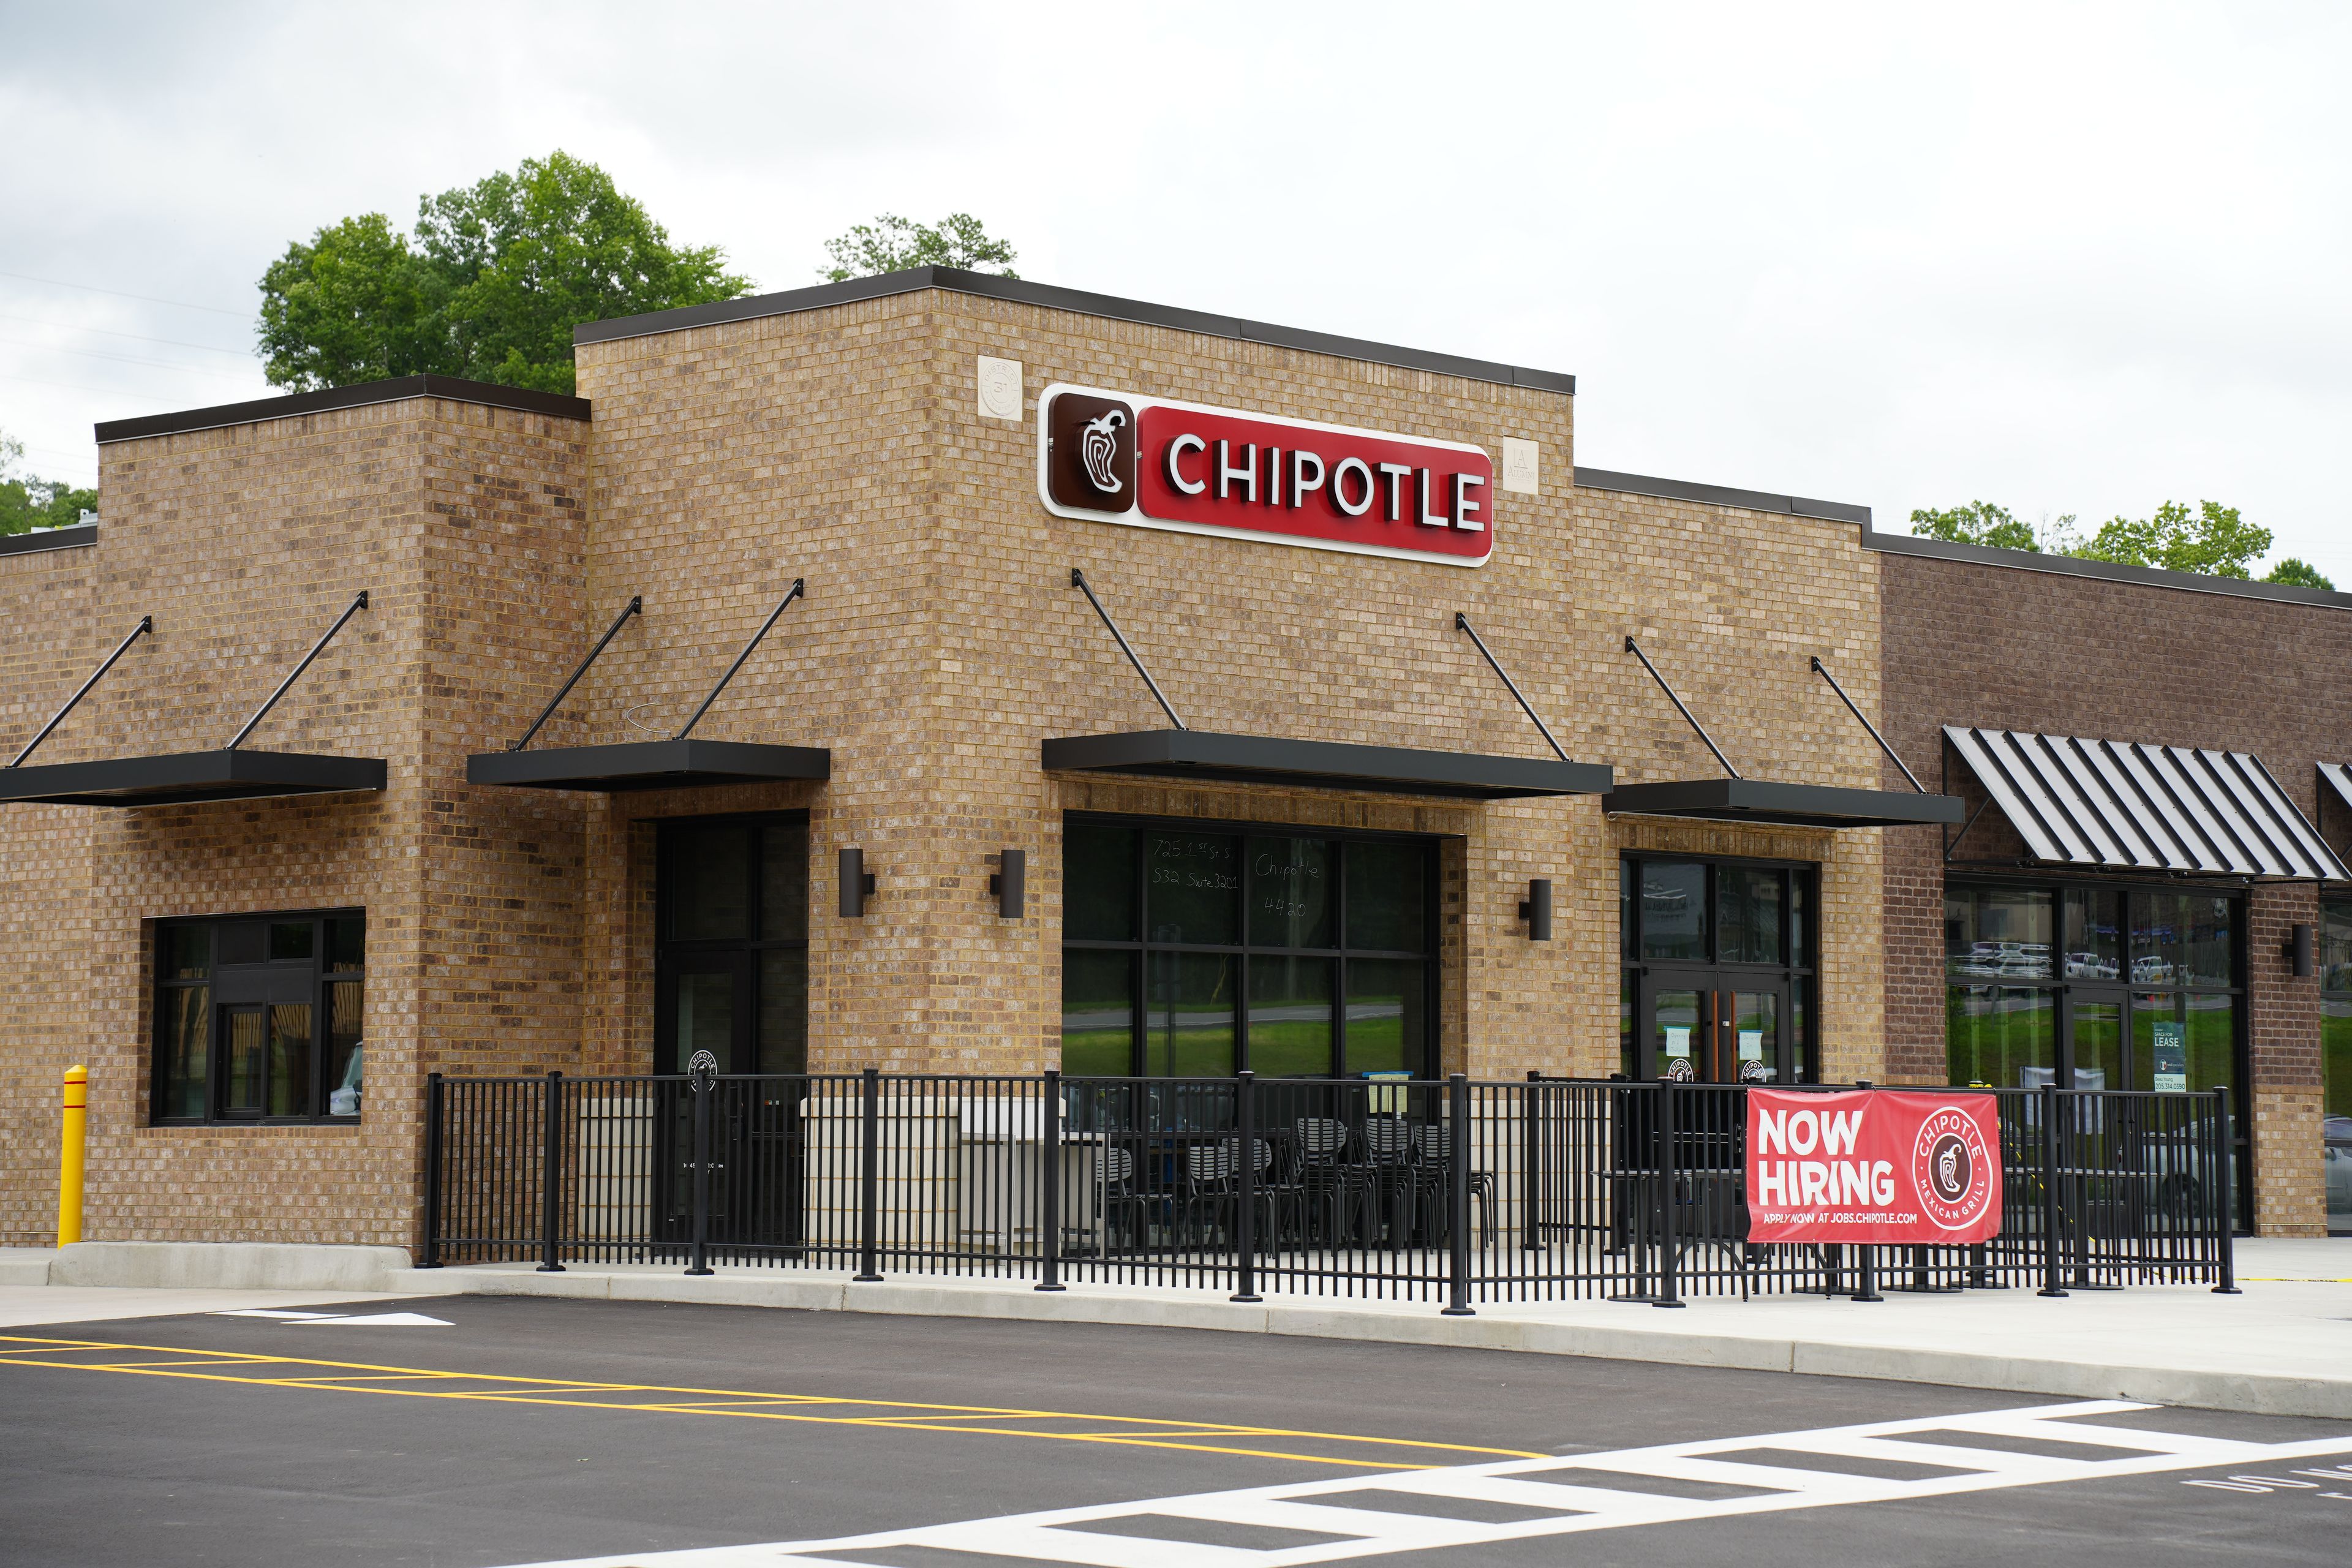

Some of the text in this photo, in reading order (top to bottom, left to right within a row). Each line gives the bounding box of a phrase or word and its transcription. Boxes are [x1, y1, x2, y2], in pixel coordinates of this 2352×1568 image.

[993, 382, 1008, 394] 31
[1162, 434, 1486, 532] CHIPOTLE
[1153, 839, 1181, 858] 725
[1256, 853, 1319, 880] Chipotle
[1265, 897, 1306, 917] 4420
[2155, 1037, 2179, 1047] LEASE
[691, 1053, 715, 1069] CHIPOTLE
[1670, 1061, 1692, 1076] CHIPOTLE
[1743, 1063, 1765, 1077] CHIPOTLE
[1758, 1109, 1863, 1156] NOW
[1919, 1115, 1982, 1160] CHIPOTLE
[1758, 1160, 1894, 1207] HIRING
[1920, 1178, 1985, 1219] MEXICAN GRILL
[1763, 1213, 1918, 1224] APPLY NOW AT JOBS.CHIPOTLE.COM
